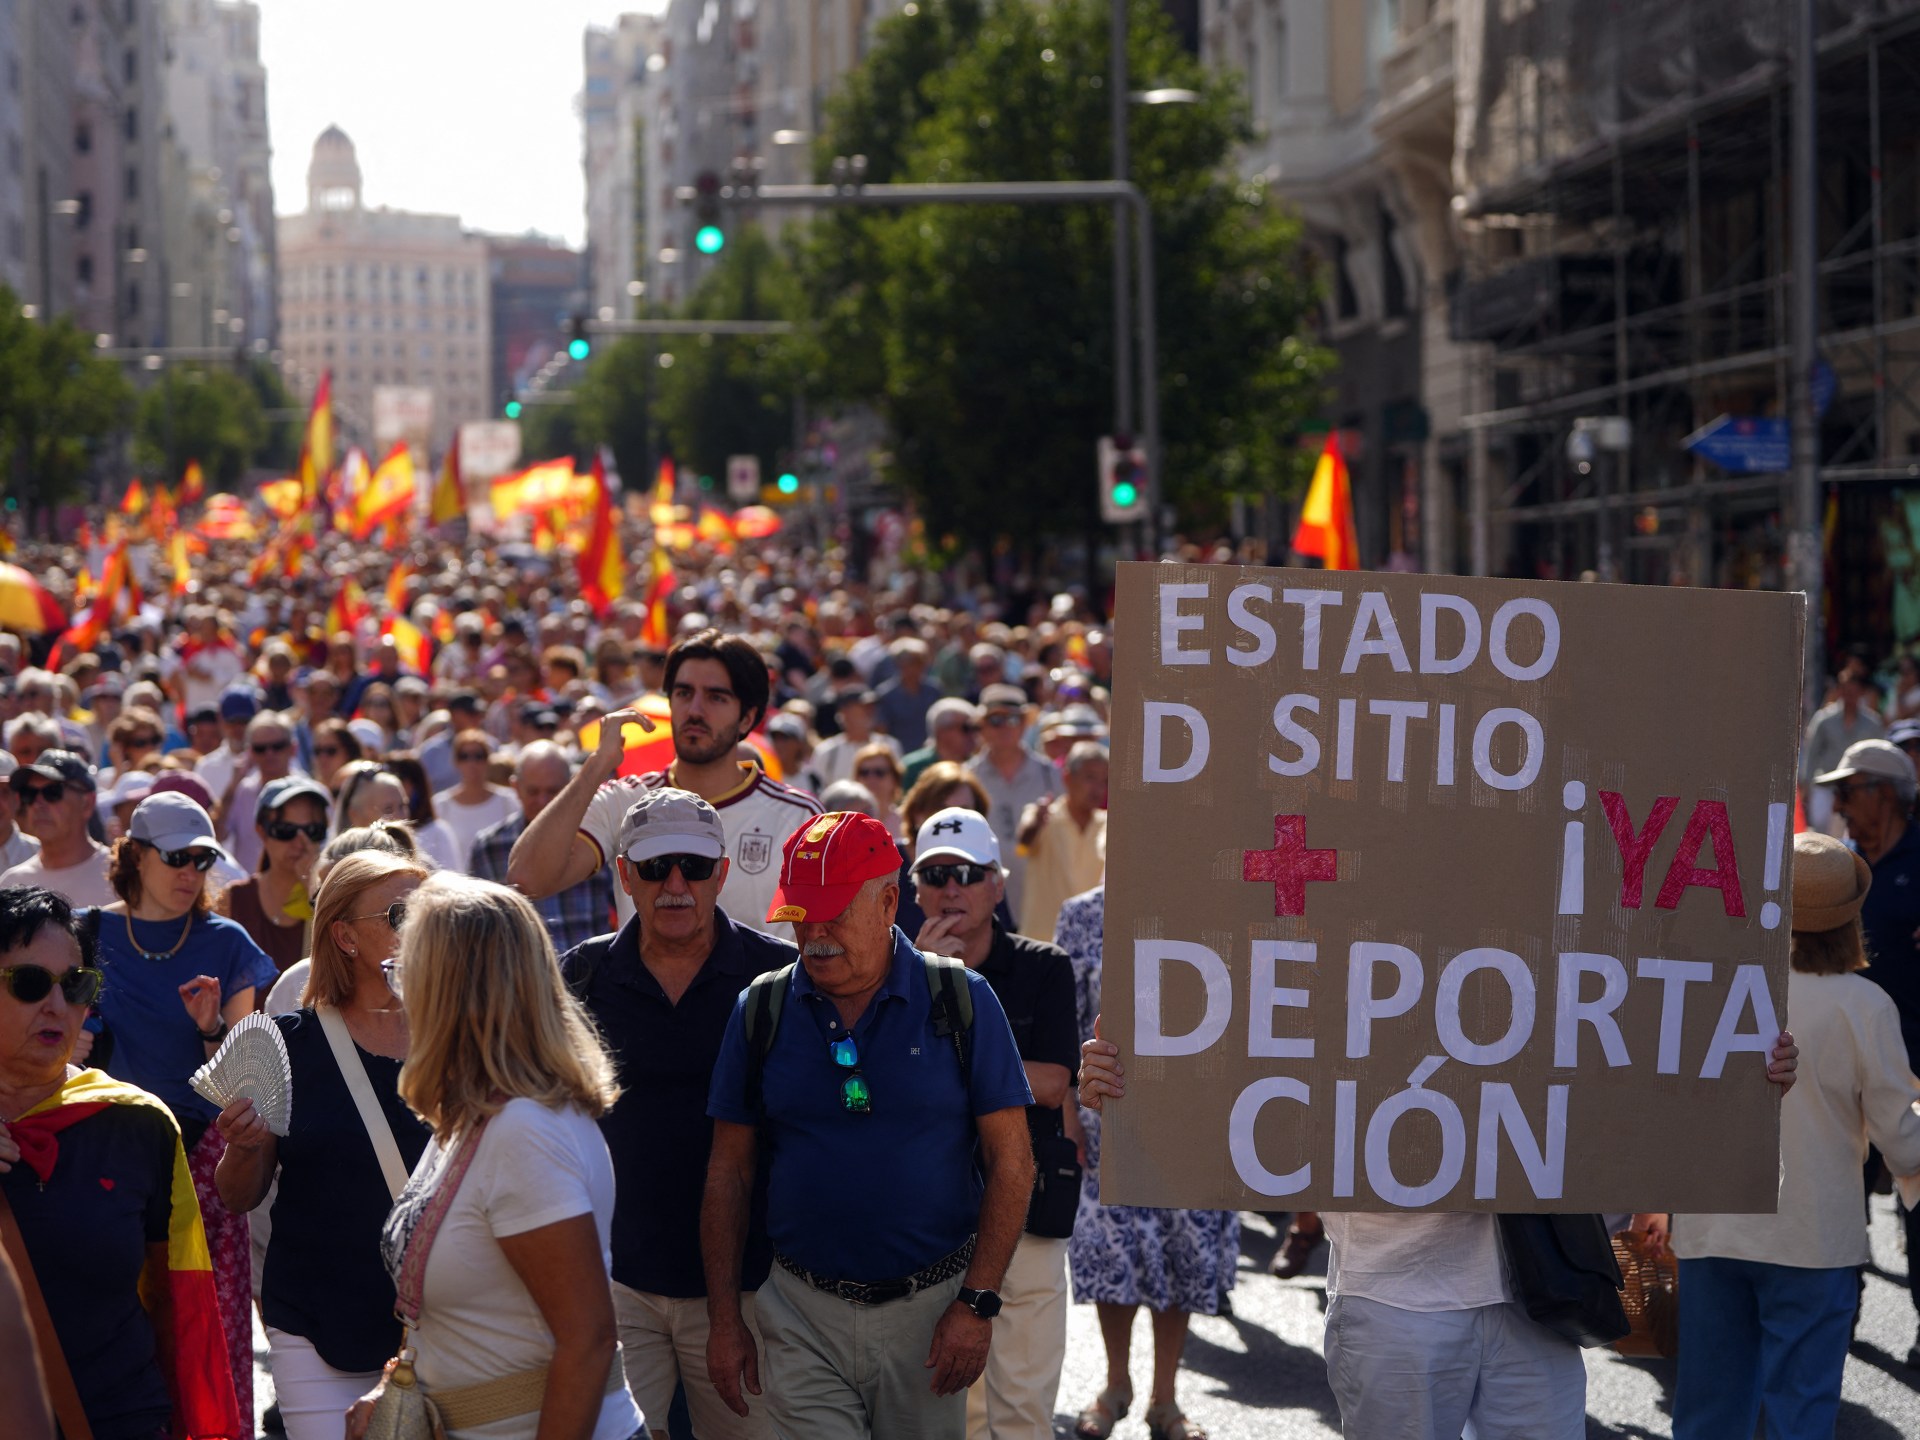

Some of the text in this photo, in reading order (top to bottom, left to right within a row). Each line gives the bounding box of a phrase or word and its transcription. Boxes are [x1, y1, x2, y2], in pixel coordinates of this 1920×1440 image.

[1159, 583, 1561, 681] ESTADO
[1142, 693, 1545, 791] D SITIO
[1558, 780, 1788, 930] ¡YA!
[1133, 939, 1782, 1079] DEPORTA
[1228, 1055, 1569, 1207] CIÓN
